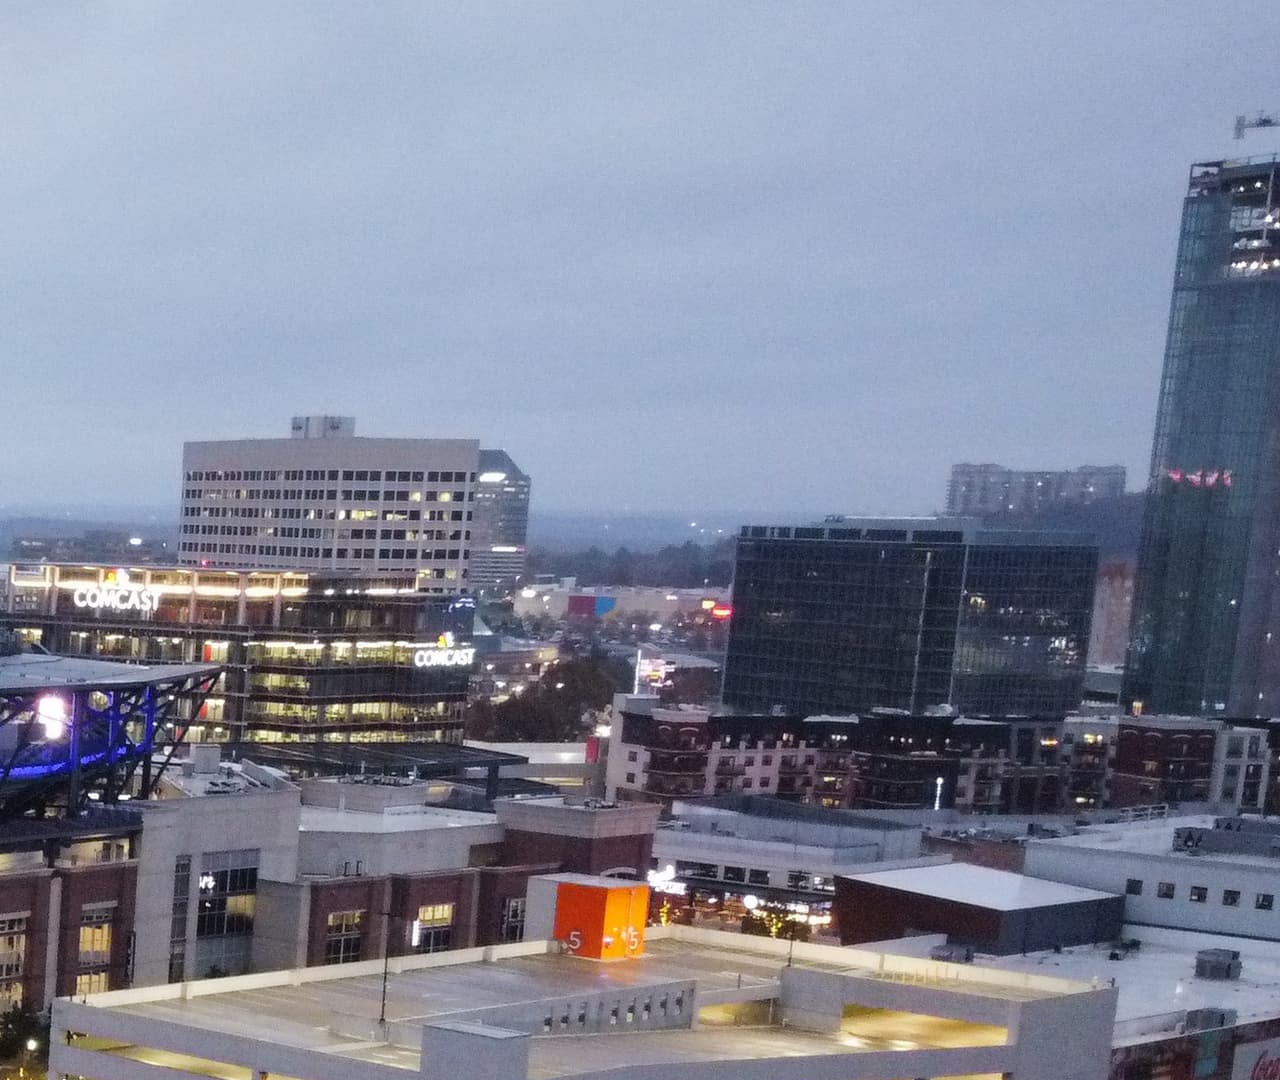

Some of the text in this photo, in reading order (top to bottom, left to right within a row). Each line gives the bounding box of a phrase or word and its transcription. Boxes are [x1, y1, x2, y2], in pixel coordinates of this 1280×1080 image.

[73, 587, 161, 612] COMCAST
[414, 648, 477, 668] COMCAST
[568, 931, 581, 950] 5
[629, 931, 640, 950] 5
